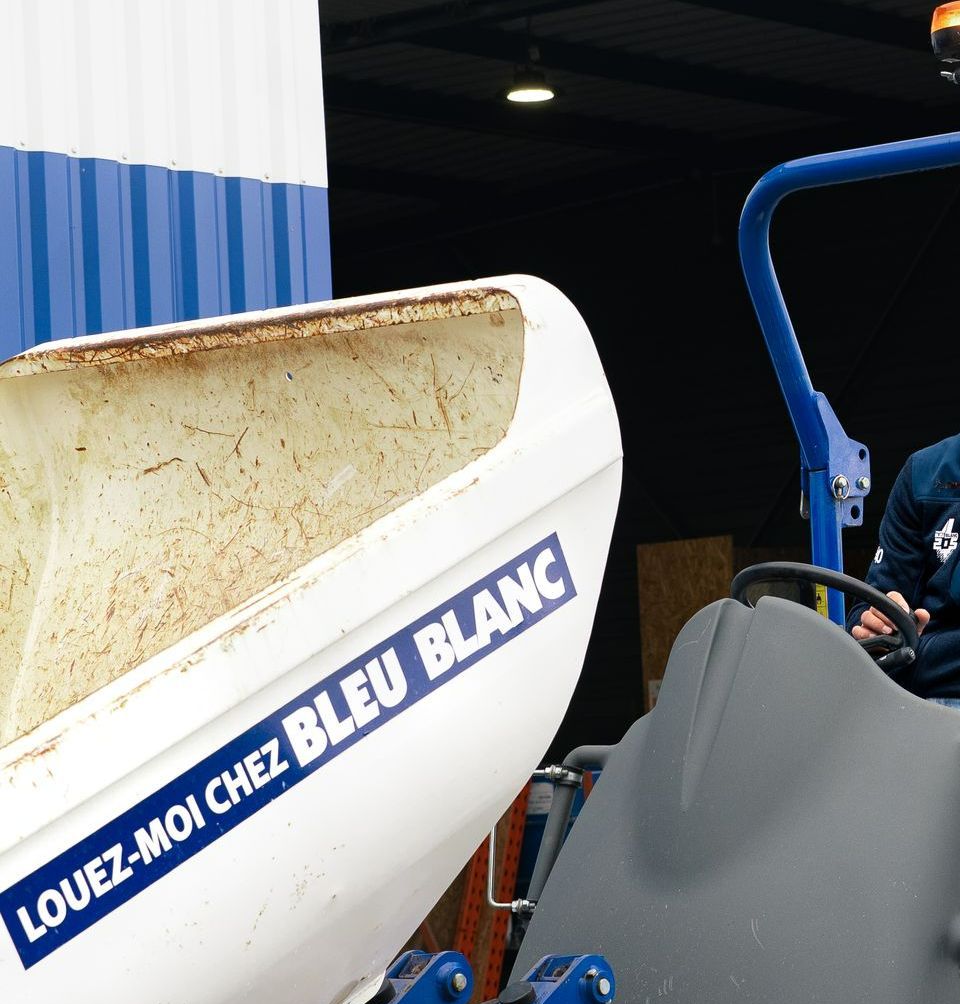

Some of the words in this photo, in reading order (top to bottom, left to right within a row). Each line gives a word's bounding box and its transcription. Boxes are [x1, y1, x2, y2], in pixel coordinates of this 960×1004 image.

[17, 796, 206, 943] LOUEZ-MOI
[205, 738, 290, 818] CHEZ
[281, 648, 407, 769] BLEU
[413, 548, 566, 681] BLANC
